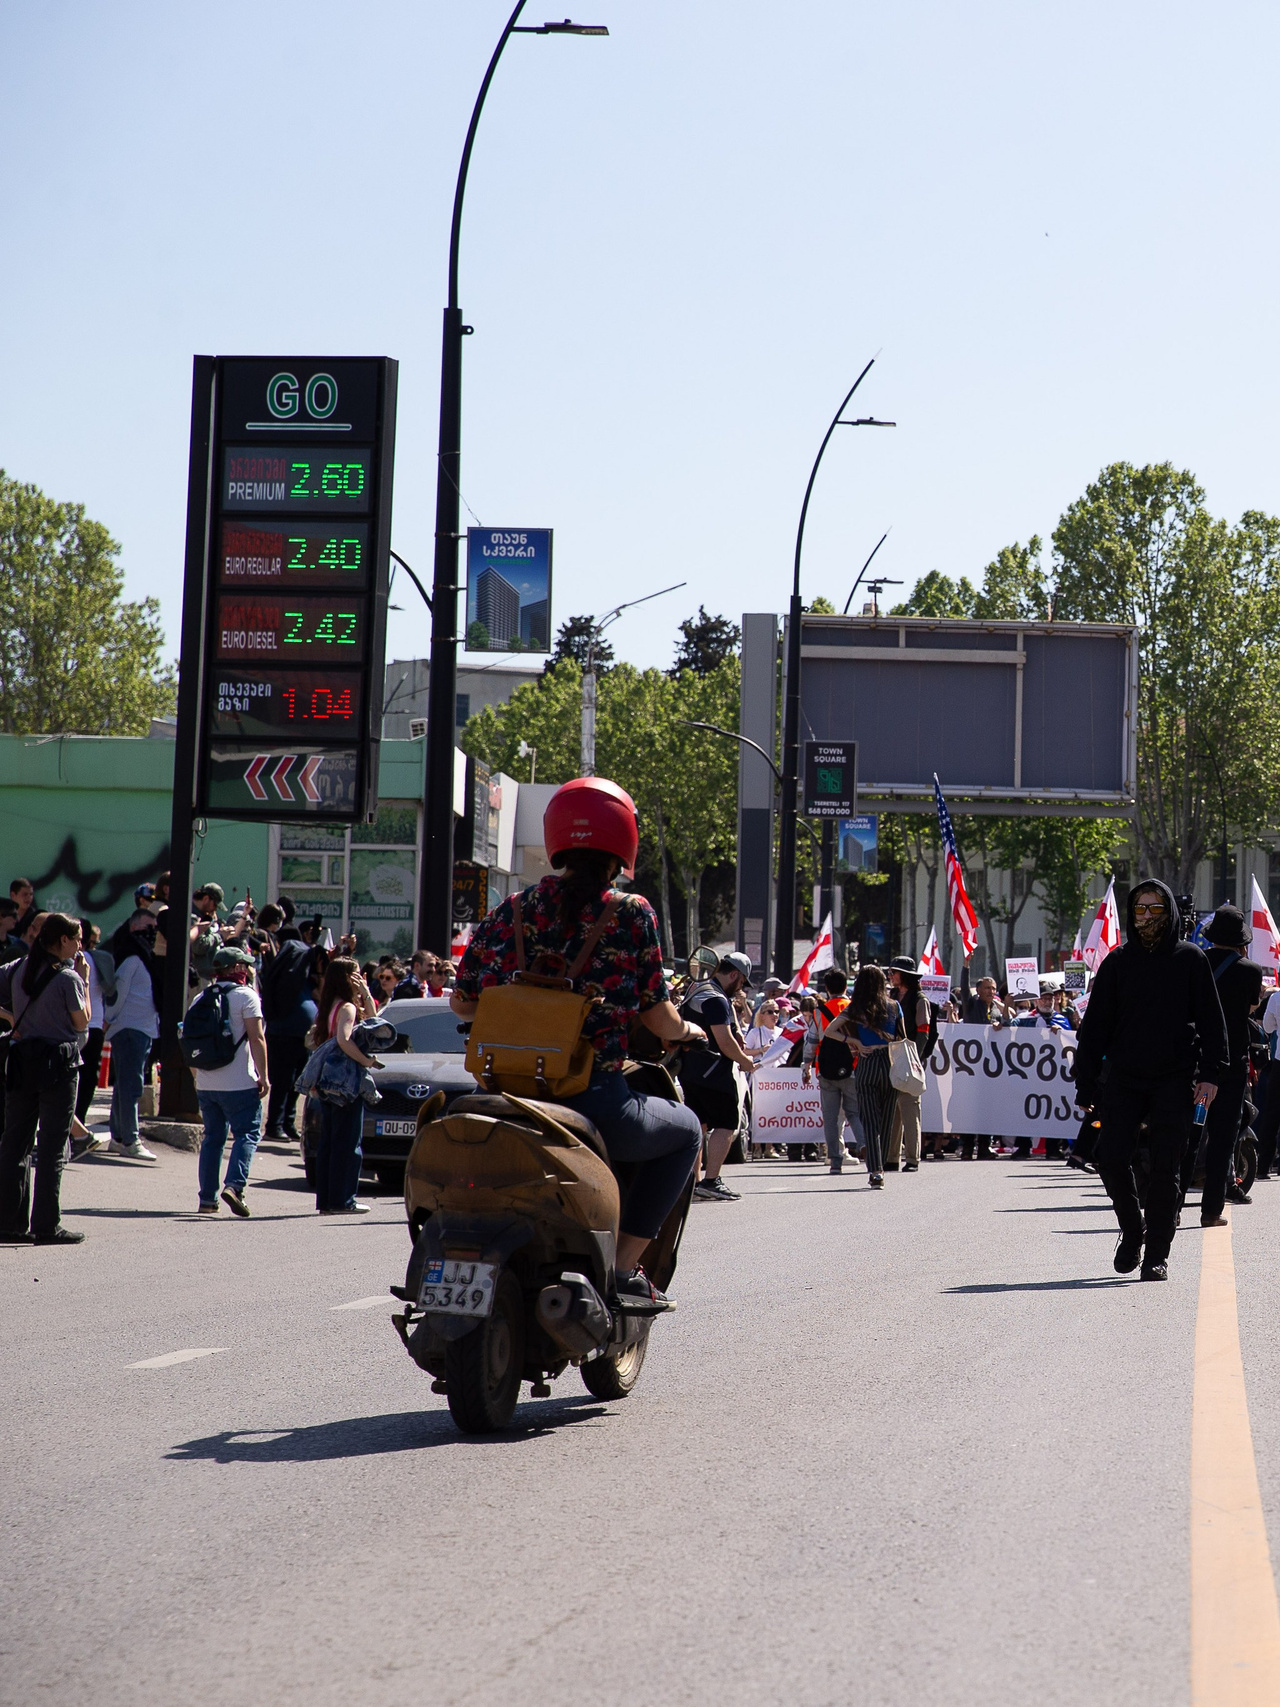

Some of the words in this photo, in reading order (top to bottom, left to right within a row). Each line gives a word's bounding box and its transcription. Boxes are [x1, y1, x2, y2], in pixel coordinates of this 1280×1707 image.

[266, 372, 338, 419] GO
[290, 463, 365, 497] 2.60
[228, 482, 285, 500] PREMIUM
[491, 533, 527, 545] თაუნ
[287, 538, 361, 569] 2.40
[482, 545, 535, 557] სკვერი
[225, 557, 245, 575] EURO
[247, 557, 282, 575] REGULAR
[283, 612, 357, 644] 2.42
[221, 630, 246, 649] EURO
[247, 631, 278, 649] DIESEL
[218, 682, 272, 697] თხევადი
[217, 697, 250, 711] გაზი
[282, 688, 353, 719] 1.04
[818, 747, 843, 755] TOWN
[452, 879, 474, 891] 24/7
[921, 1038, 1078, 1083] ადადგე
[758, 1081, 799, 1091] უშენოდ
[785, 1101, 823, 1113] ძალ
[758, 1115, 826, 1128] ერთობა
[427, 1272, 439, 1281] GE
[444, 1262, 477, 1285] JJ
[422, 1286, 484, 1310] 5349
